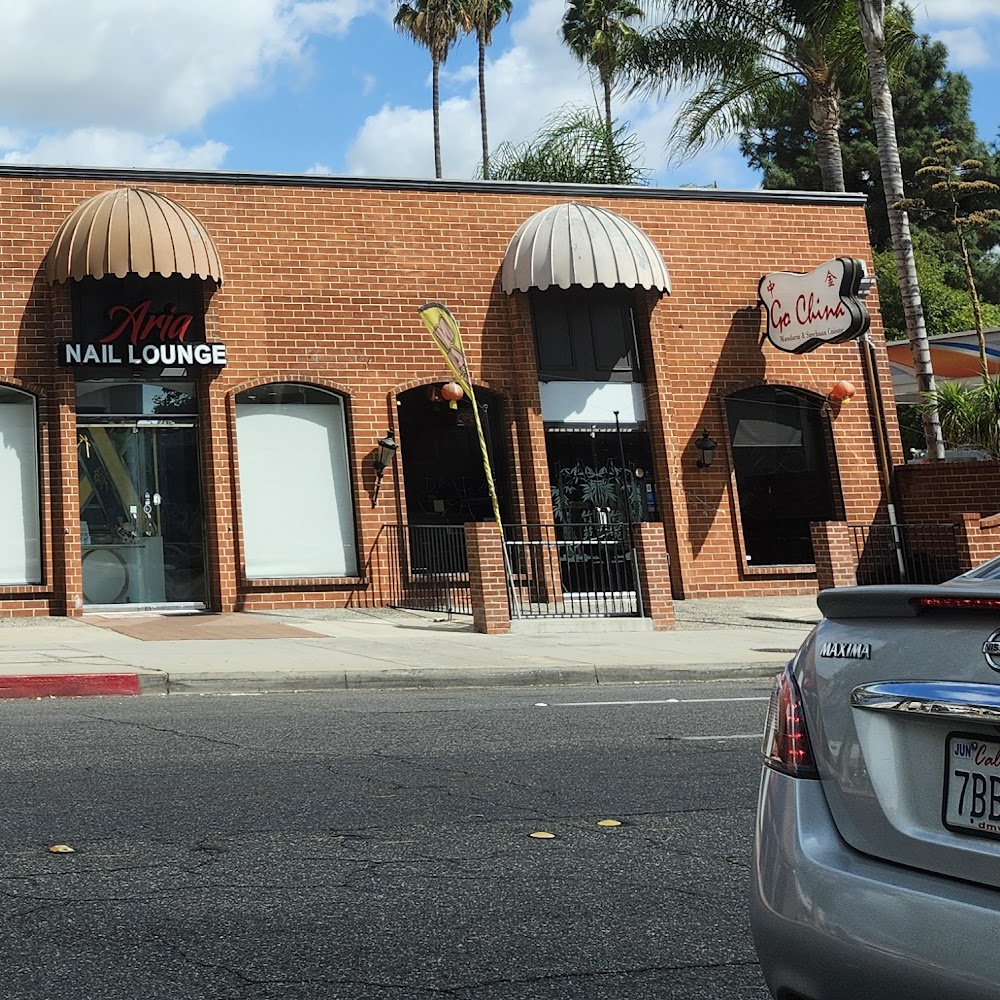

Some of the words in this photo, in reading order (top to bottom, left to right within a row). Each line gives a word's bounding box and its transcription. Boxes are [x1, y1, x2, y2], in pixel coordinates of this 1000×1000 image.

[99, 299, 194, 345] Aria
[770, 299, 791, 333] Go
[796, 292, 845, 325] China
[65, 343, 121, 364] NAIL
[128, 344, 227, 365] LOUNGE
[820, 642, 871, 660] MAXIMA
[954, 743, 971, 758] JUN
